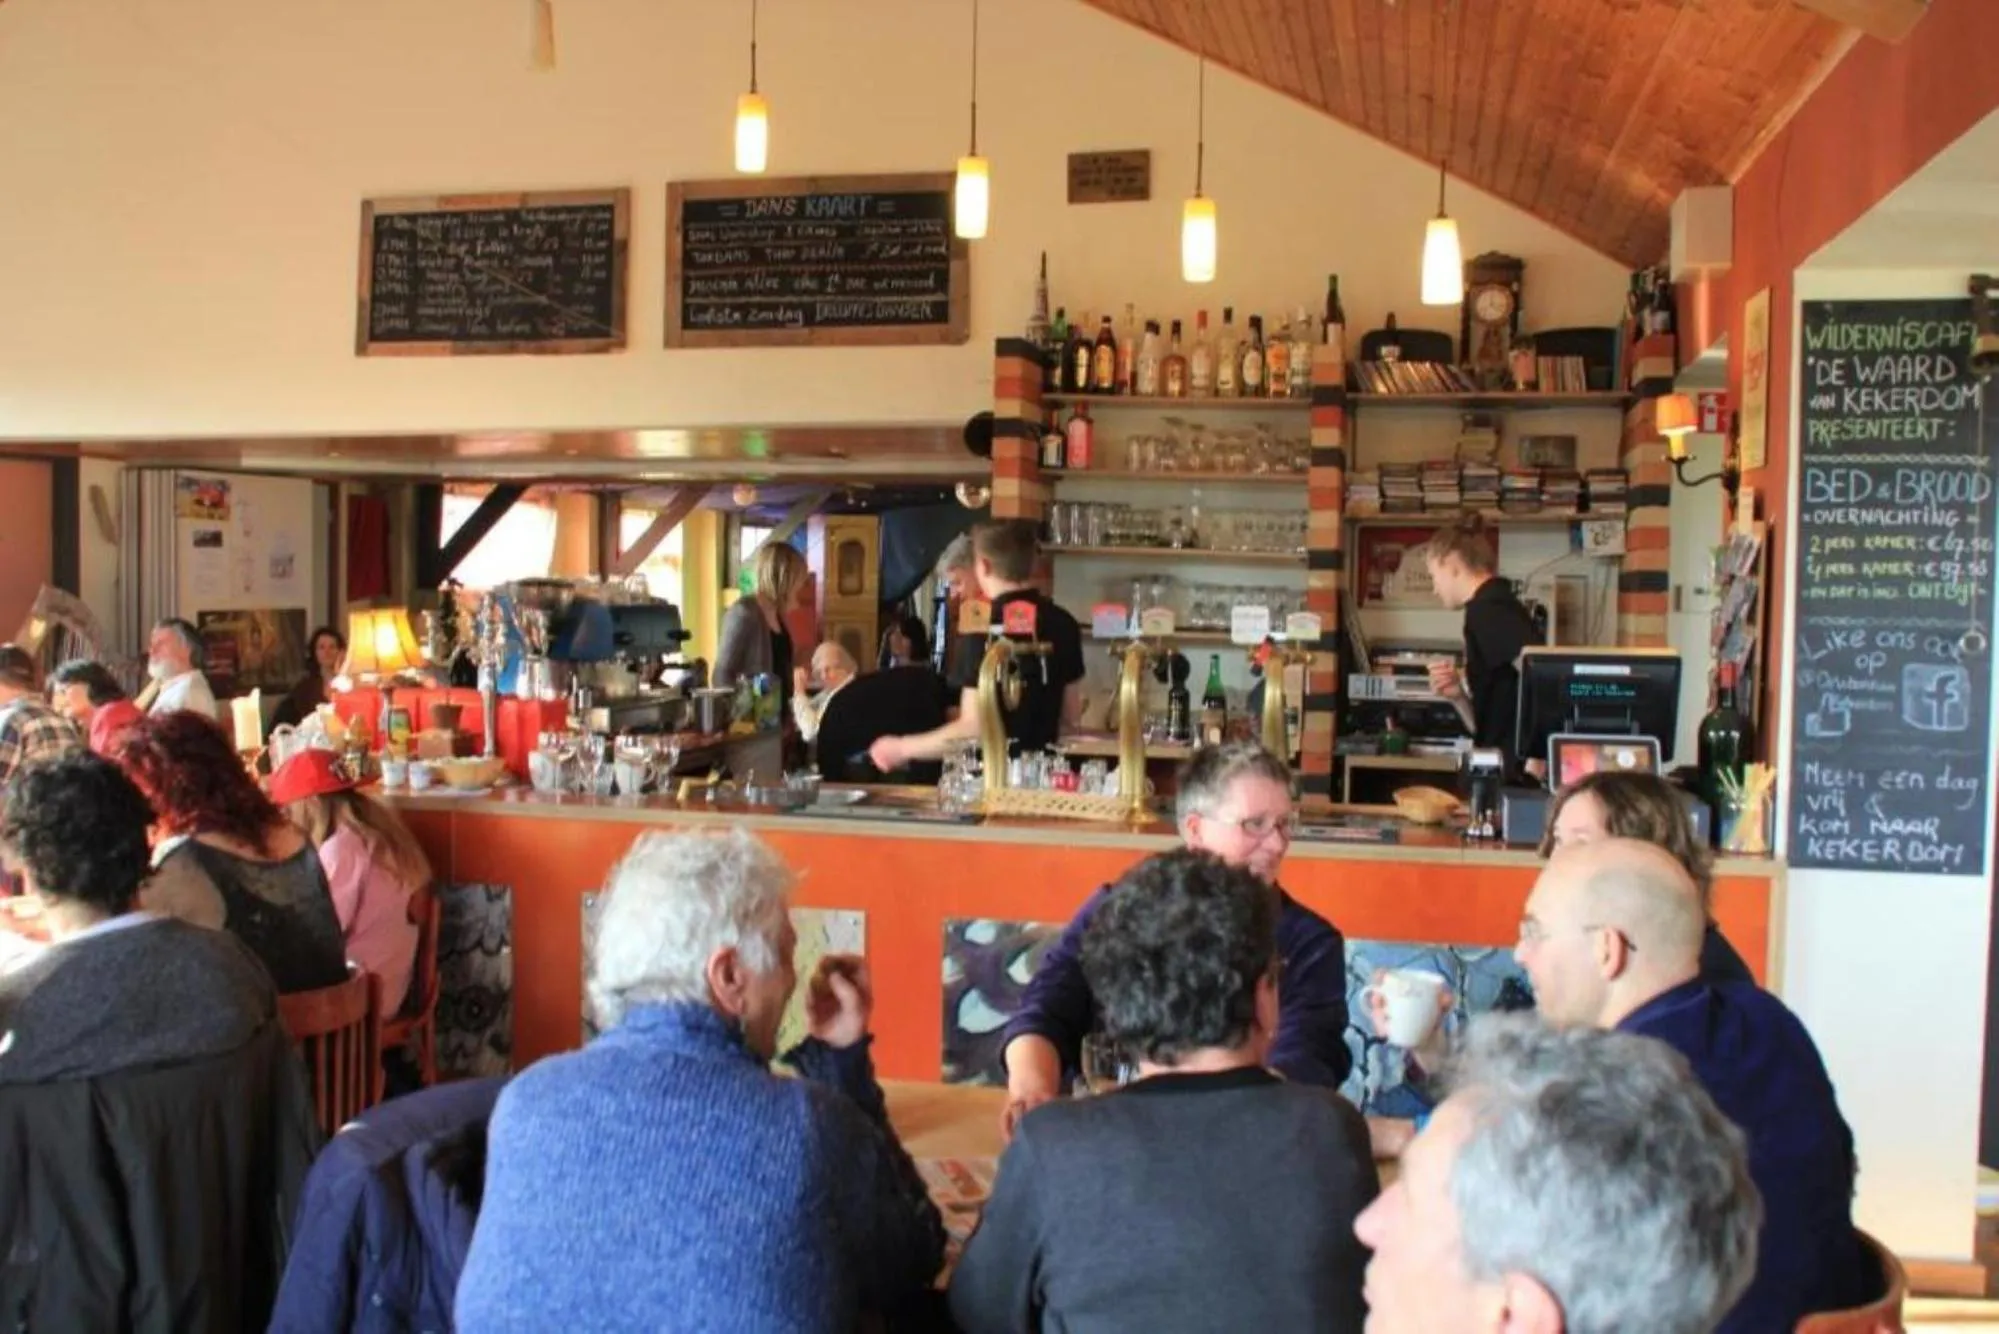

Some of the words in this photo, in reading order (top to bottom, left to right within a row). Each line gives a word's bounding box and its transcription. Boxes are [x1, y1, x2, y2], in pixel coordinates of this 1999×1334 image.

[744, 196, 798, 218] DANS
[804, 194, 874, 217] KAART
[1853, 354, 1957, 385] WAARD
[1806, 469, 1873, 503] BED
[1894, 468, 1991, 506] BROOD
[1810, 535, 1821, 554] 2
[1800, 629, 1867, 660] Like
[1876, 630, 1917, 650] ons
[1855, 651, 1888, 675] op
[1935, 764, 1980, 811] dag
[1806, 789, 1847, 817] vrij
[1869, 816, 1941, 844] NAAR
[1806, 837, 1966, 867] KEKERDOM
